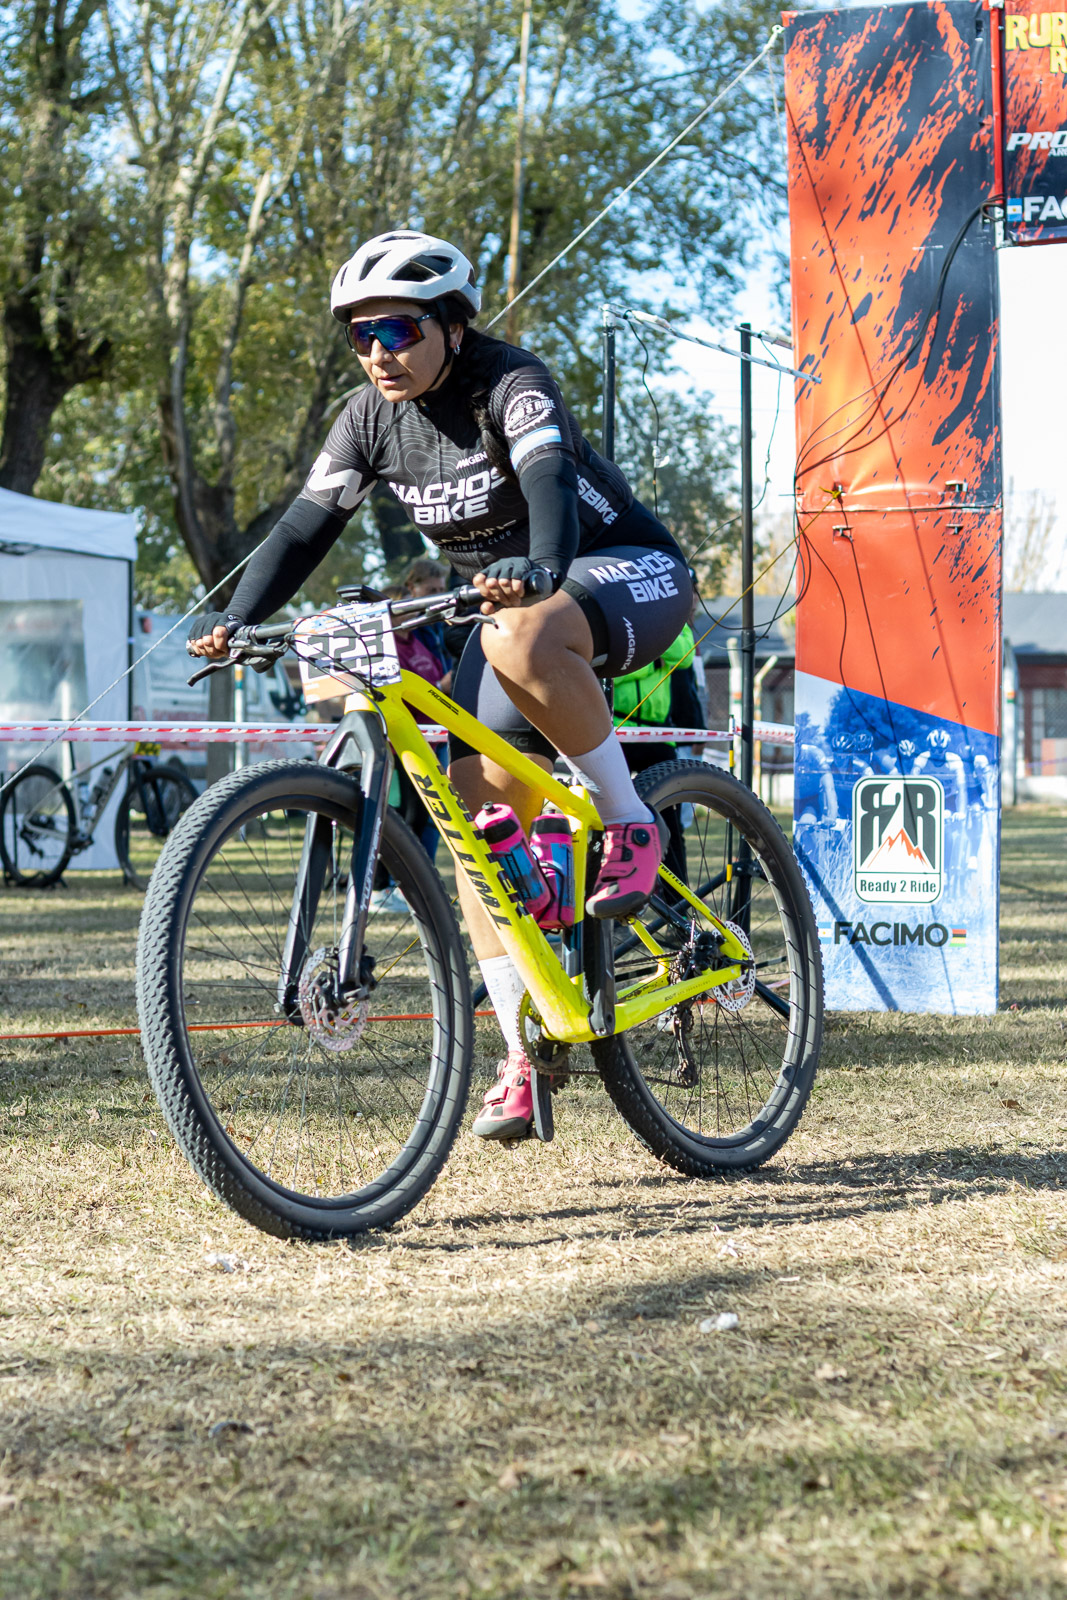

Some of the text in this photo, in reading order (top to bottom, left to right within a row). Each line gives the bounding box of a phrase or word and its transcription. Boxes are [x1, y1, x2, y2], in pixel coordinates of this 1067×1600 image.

[389, 466, 506, 506] NACHOS
[577, 475, 618, 525] SBIKE
[414, 494, 489, 525] BIKE
[588, 551, 675, 584] NACHOS
[626, 573, 679, 603] BIKE
[621, 616, 636, 671] MAGENTA
[411, 772, 512, 930] TWITTER
[660, 863, 684, 887] WITTER
[860, 879, 936, 893] Ready 2 Ride
[834, 922, 949, 947] FACIMO
